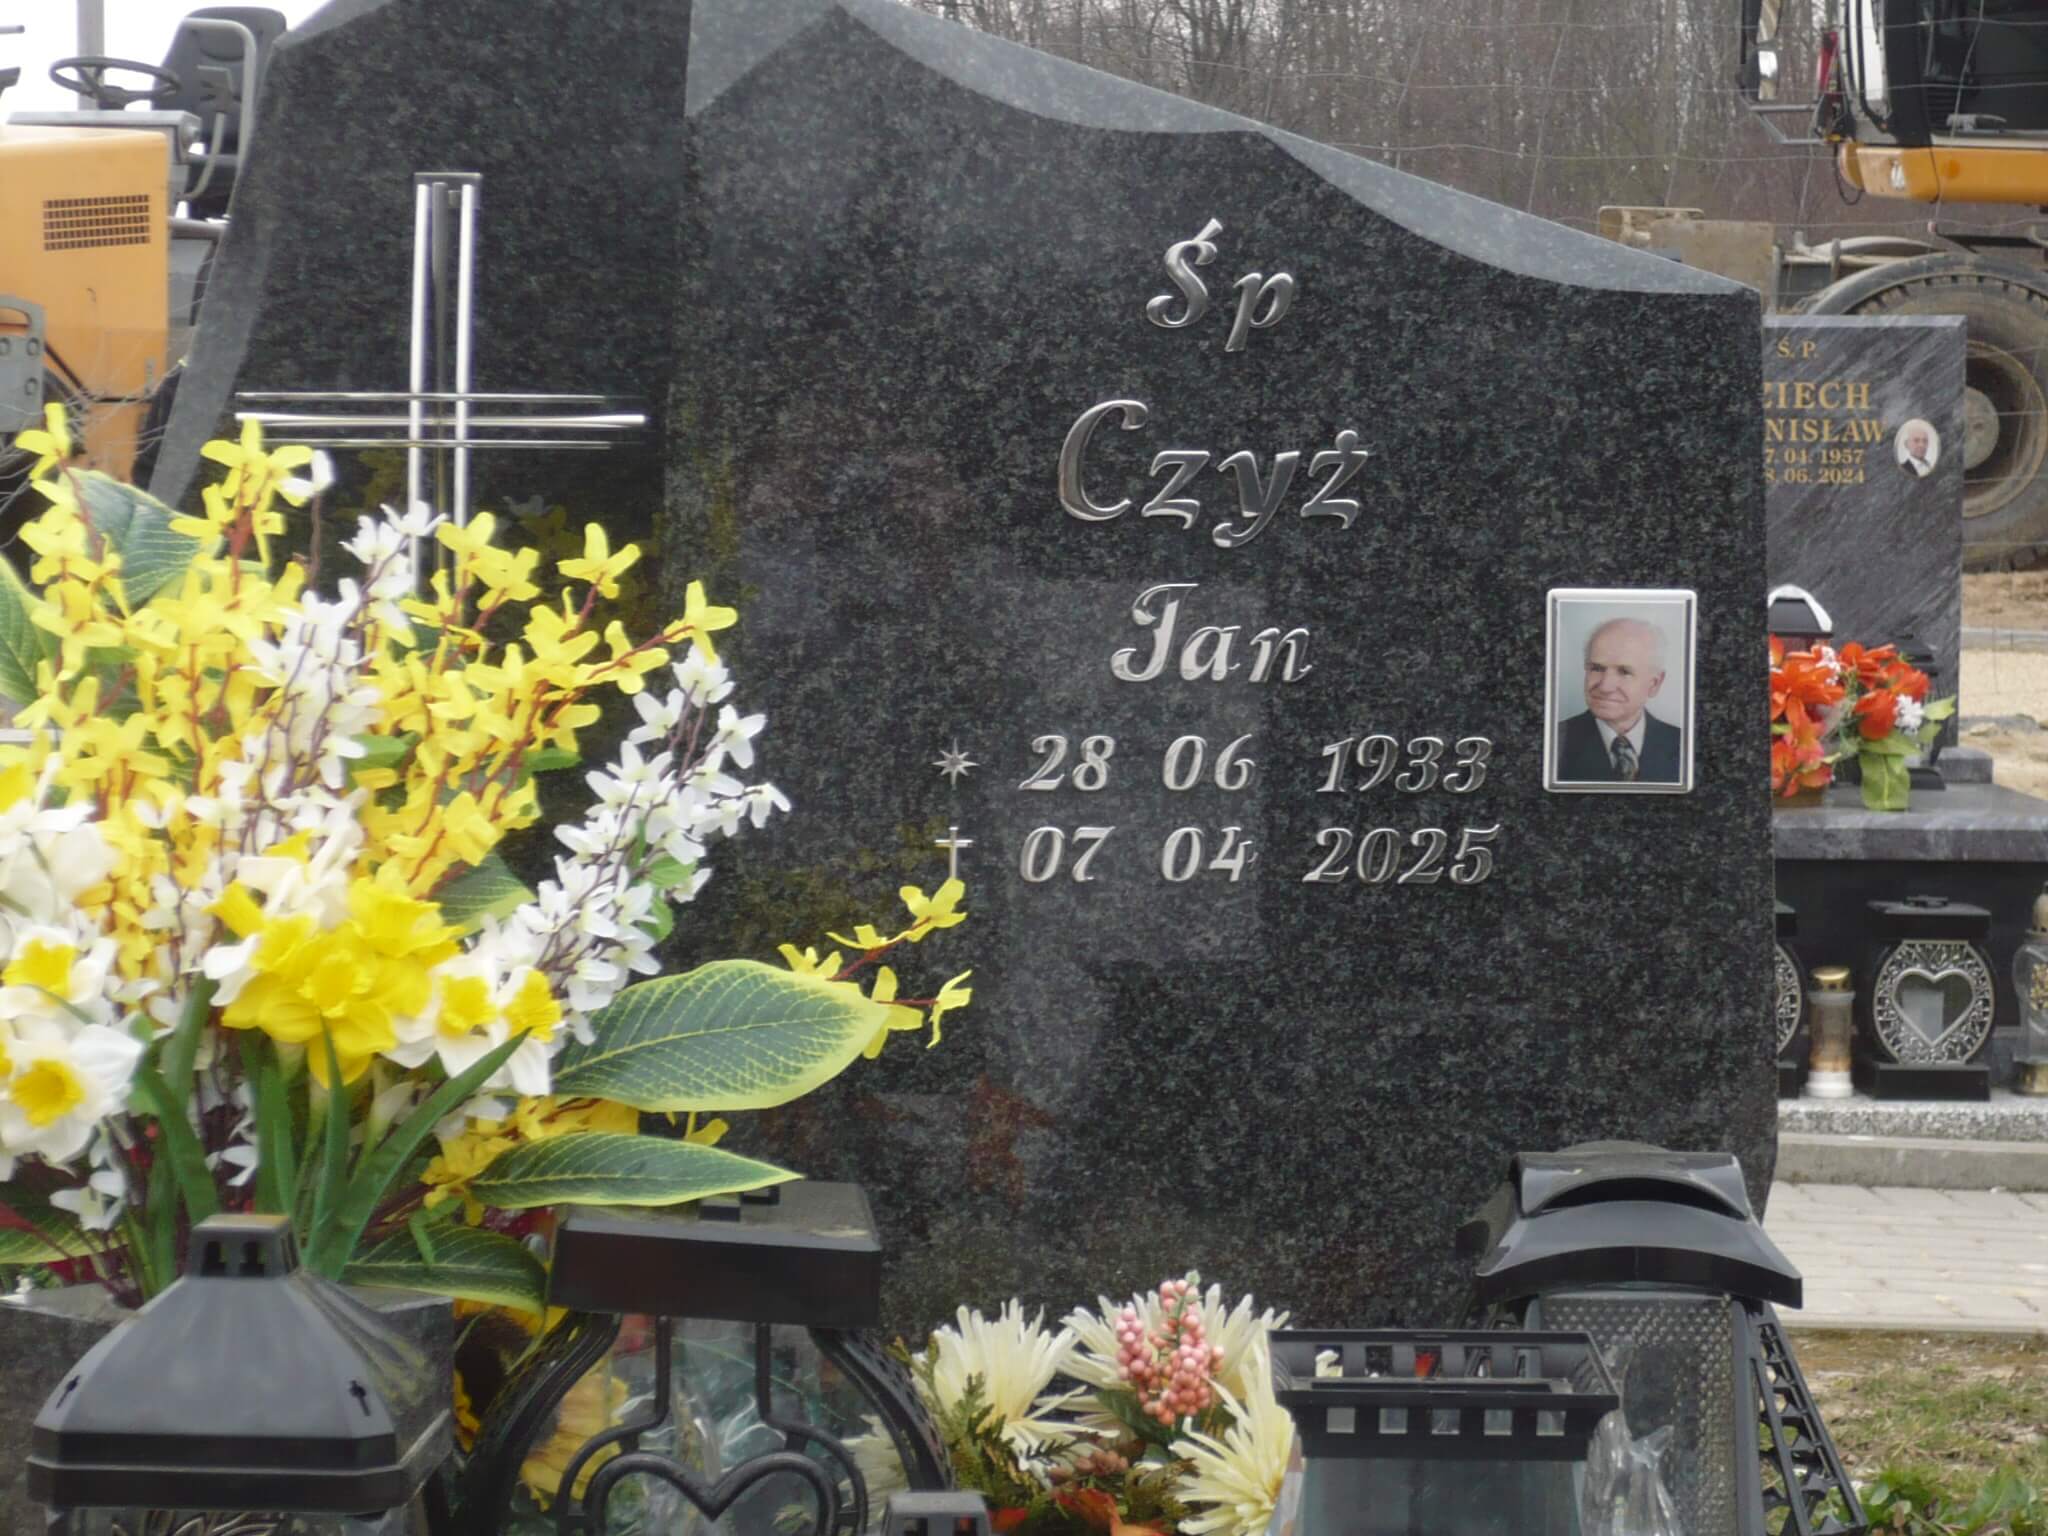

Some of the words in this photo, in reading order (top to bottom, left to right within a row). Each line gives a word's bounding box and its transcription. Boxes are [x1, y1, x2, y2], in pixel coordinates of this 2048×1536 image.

[1058, 399, 1369, 548] Czyż
[1111, 583, 1313, 682] Jan
[1018, 734, 1116, 791] 28
[1162, 733, 1257, 791] 06
[1317, 735, 1493, 793] 1933
[1020, 825, 1116, 882] 07
[1161, 826, 1259, 882] 04
[1303, 823, 1500, 883] 2025
